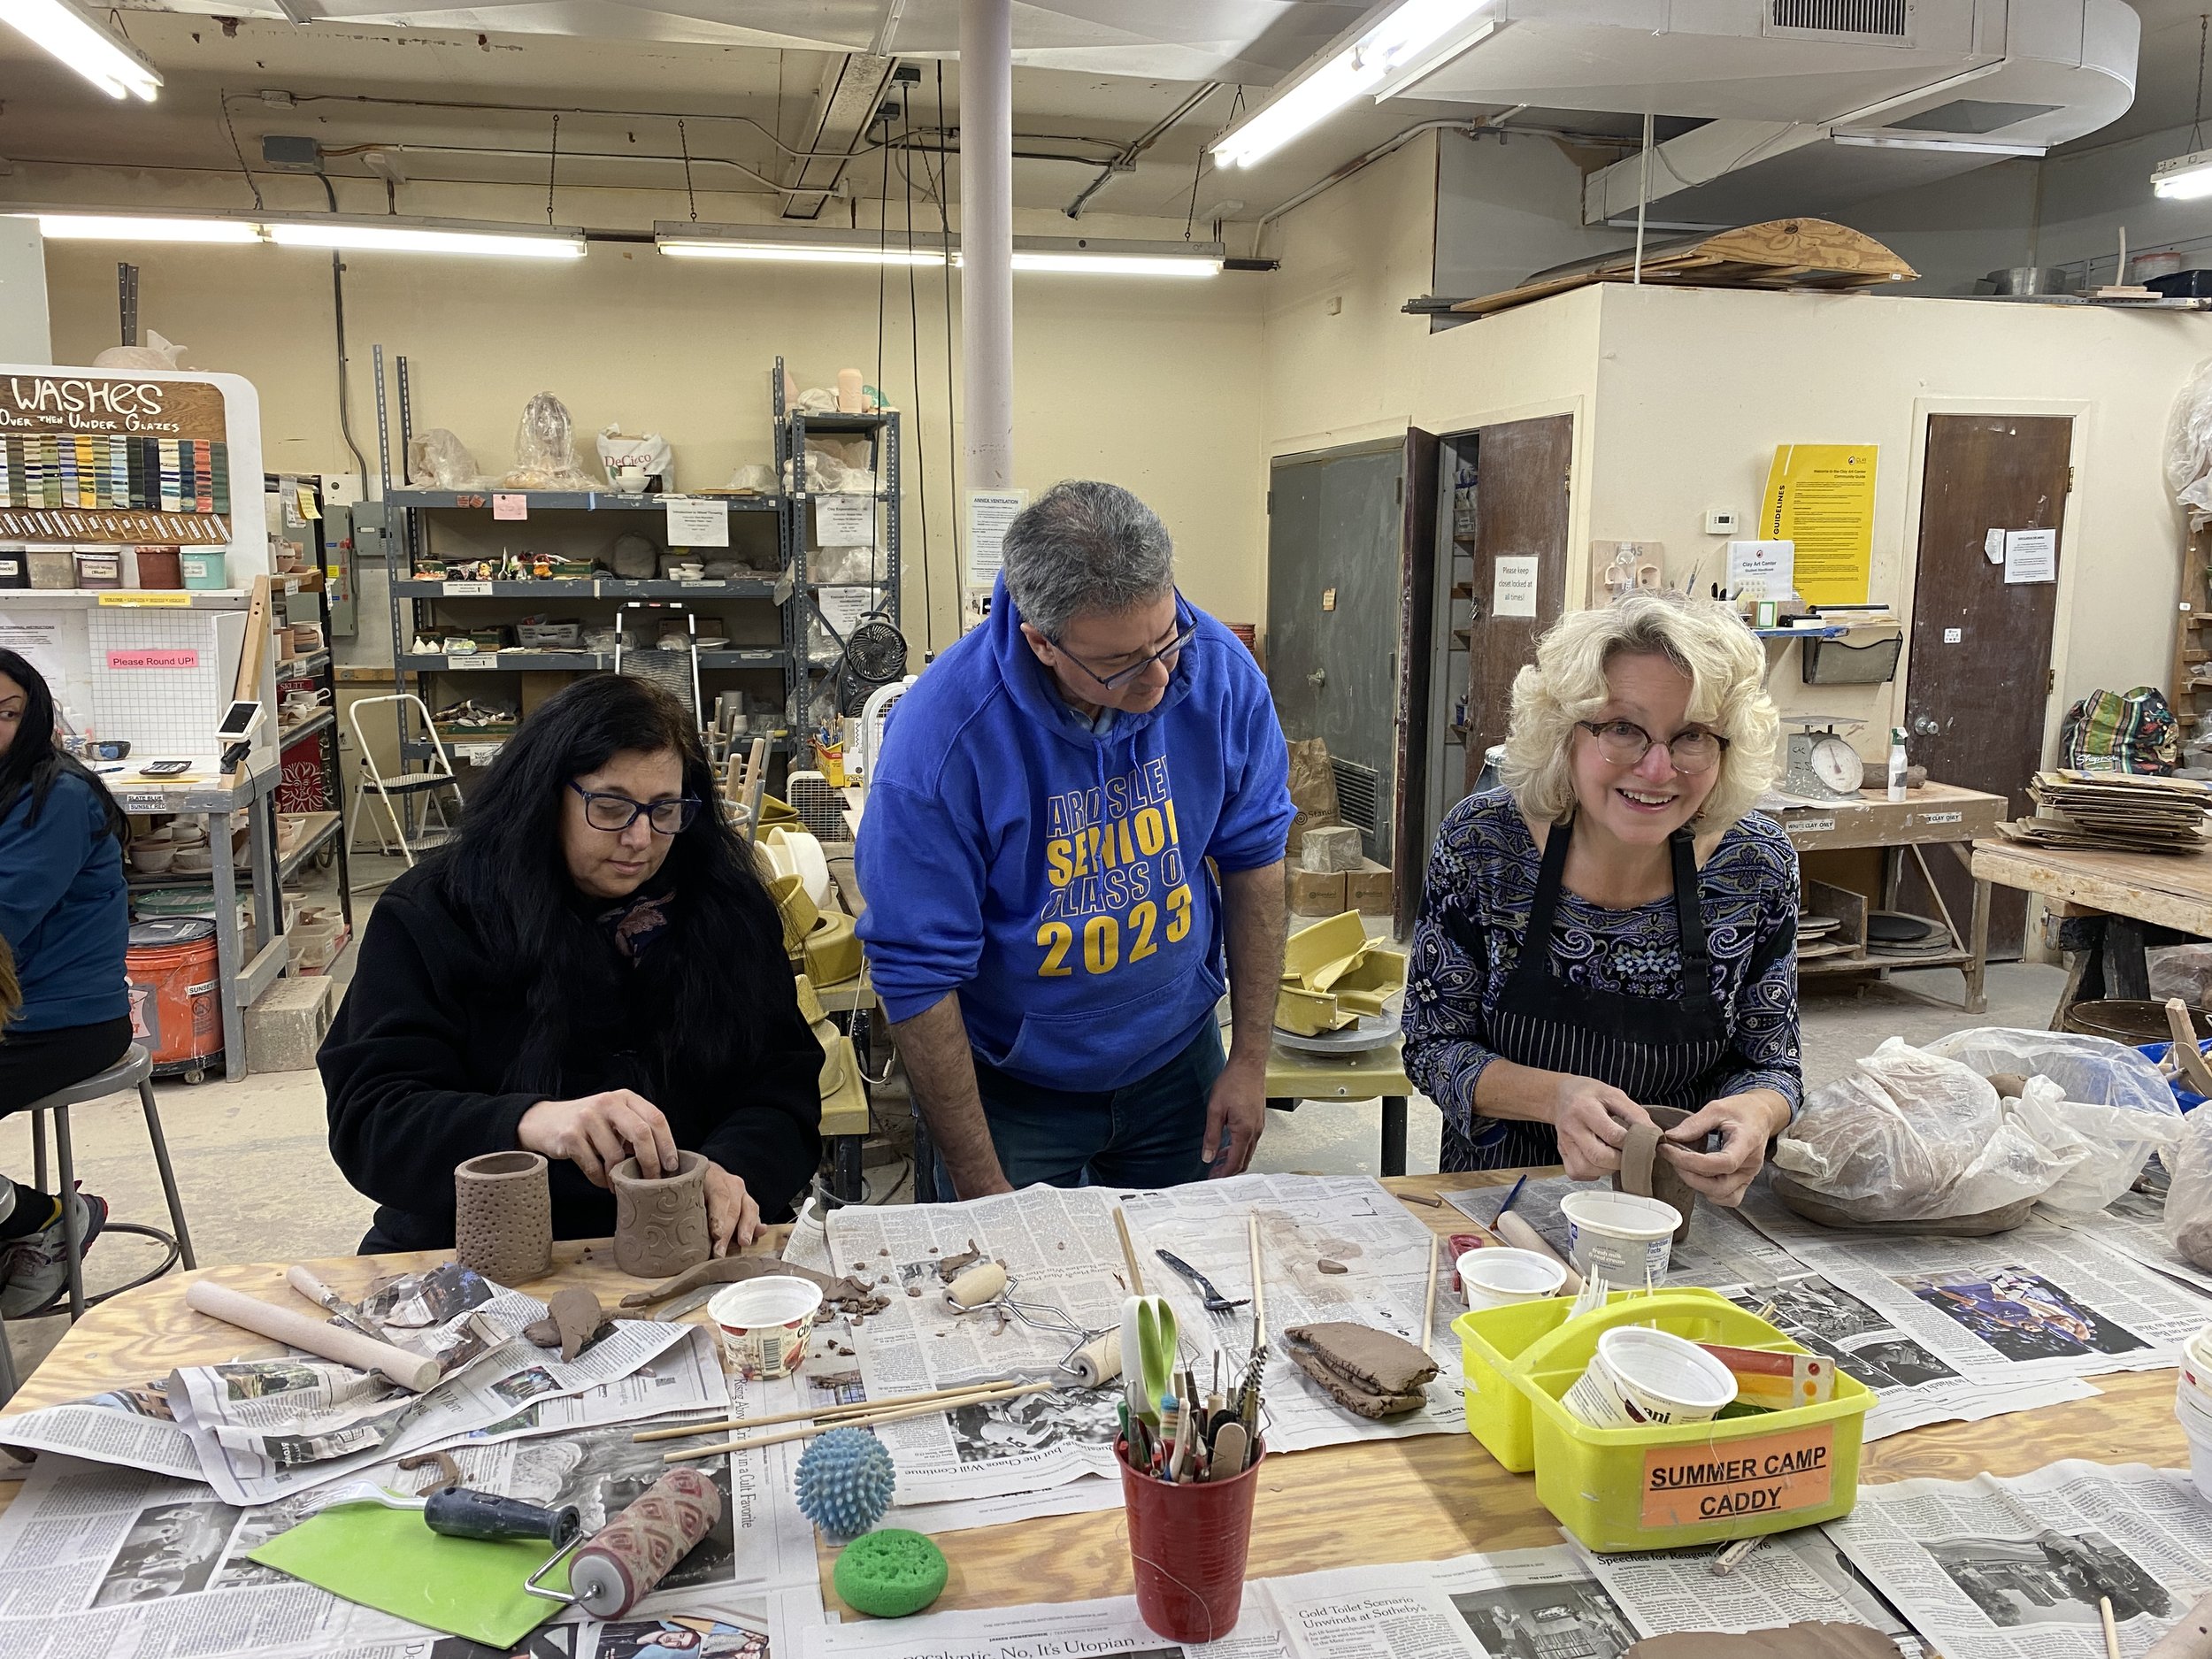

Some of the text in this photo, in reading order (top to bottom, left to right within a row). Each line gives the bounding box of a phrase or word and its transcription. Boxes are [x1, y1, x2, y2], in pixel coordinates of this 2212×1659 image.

[0, 408, 180, 433] OVER THEN UNDER GLAZES
[1773, 485, 1786, 535] GUIDELINES
[1517, 566, 1530, 576] keep
[1510, 593, 1525, 602] times!
[112, 657, 195, 665] Please Round UP!
[1046, 755, 1173, 838] ARDSLE
[1161, 848, 1188, 887] O
[1036, 883, 1193, 977] 2023
[188, 983, 213, 995] SUNSET
[1592, 1248, 1608, 1256] fresh
[1593, 1252, 1606, 1262] real
[1606, 1256, 1626, 1265] cream
[733, 1379, 749, 1400] Rising
[1927, 1380, 1955, 1390] Watch
[735, 1401, 749, 1421] Abov
[735, 1426, 751, 1457] Criy
[1023, 1453, 1042, 1463] the
[1042, 1447, 1063, 1458] but
[739, 1458, 752, 1467] in
[904, 1466, 957, 1477] Continue
[959, 1463, 986, 1473] Will
[986, 1457, 1021, 1469] Chaos
[1649, 1446, 1827, 1488] SUMMER CAMP
[739, 1474, 755, 1492] Cult
[1700, 1486, 1782, 1517] CADDY
[741, 1493, 757, 1529] Favorite
[1597, 1554, 1651, 1567] Speeches
[1651, 1552, 1668, 1562] for
[1669, 1550, 1717, 1563] Reagan,
[1298, 1596, 1414, 1619] Gold Toilet Scenario
[1302, 1615, 1357, 1629] Unwinds
[1371, 1603, 1428, 1619] Sotheby's
[1001, 1637, 1135, 1659] No, It's Utopian
